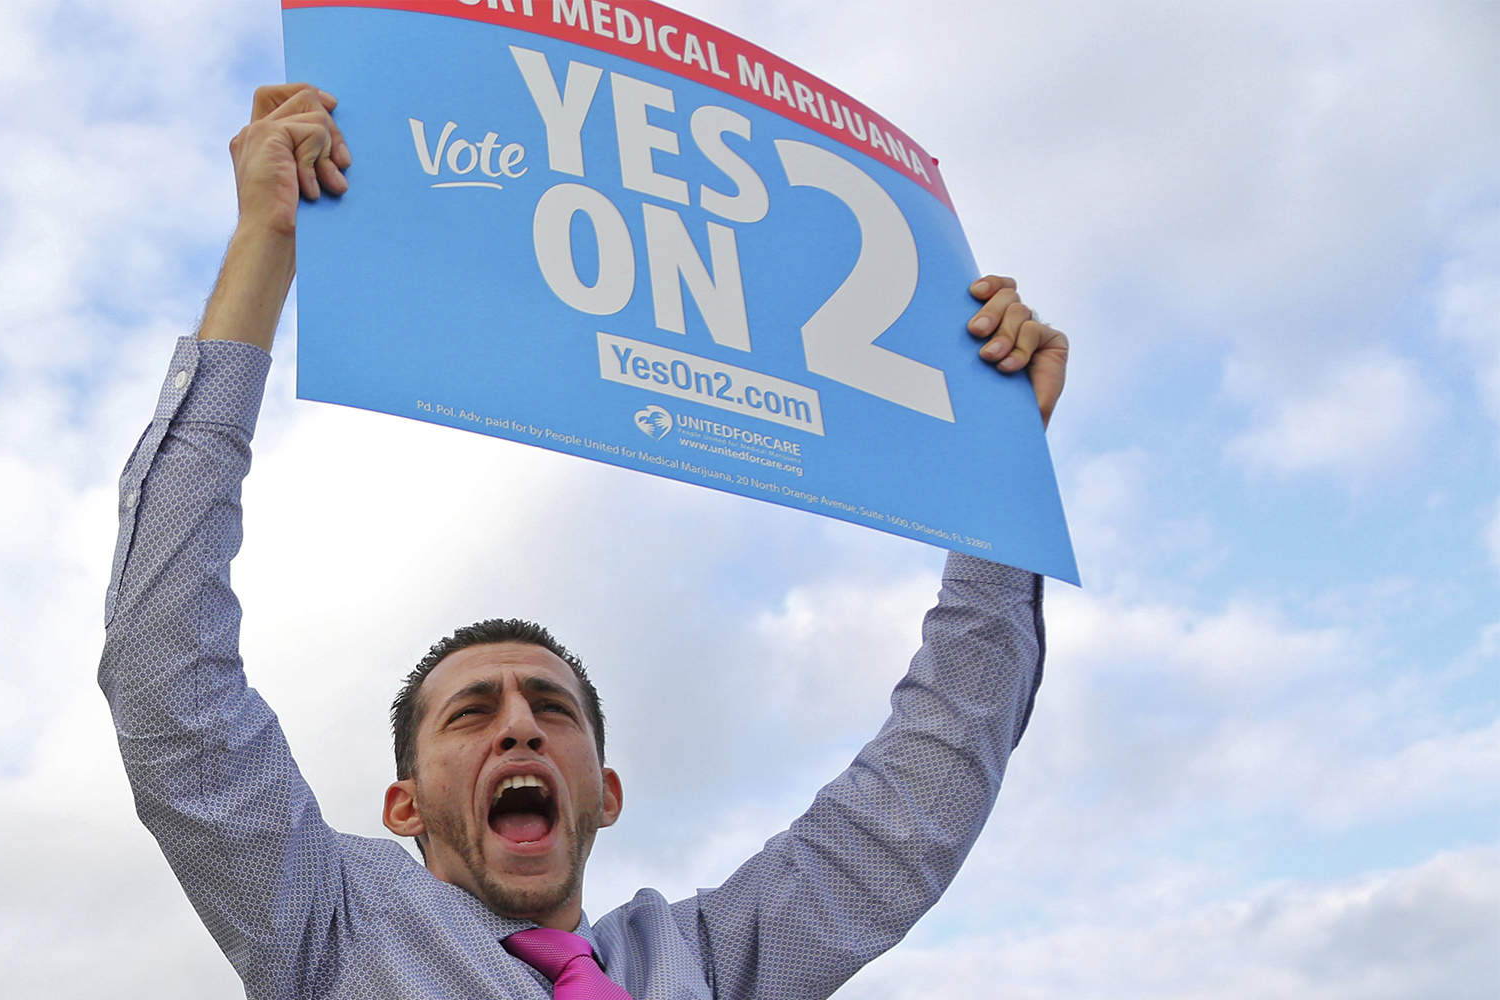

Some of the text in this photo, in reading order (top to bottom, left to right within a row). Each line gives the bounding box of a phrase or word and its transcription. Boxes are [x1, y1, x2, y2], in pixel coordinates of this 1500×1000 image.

[408, 117, 529, 180] Vote
[508, 44, 770, 224] YES
[552, 0, 933, 185] MEDICAL MARIJUANA
[531, 182, 752, 354] ON
[773, 137, 956, 423] 2
[610, 343, 813, 425] YesOn2.com
[676, 413, 802, 456] UNITEDFORCARE
[417, 399, 434, 413] Pd.
[436, 403, 457, 418] Pol.
[459, 409, 483, 424] Adv.
[485, 416, 510, 430] paid
[511, 420, 528, 434] for
[529, 424, 544, 439] by
[545, 427, 583, 446] People
[584, 437, 620, 456] United
[621, 446, 637, 460] for
[638, 450, 680, 469] Medical
[681, 460, 735, 484] Marijuana,
[736, 473, 750, 487] 20
[750, 477, 781, 495] North
[782, 484, 819, 504] Orange
[821, 495, 860, 515] Avenue,
[860, 505, 885, 521] Suite
[678, 437, 805, 478] www.unitedforcare.org
